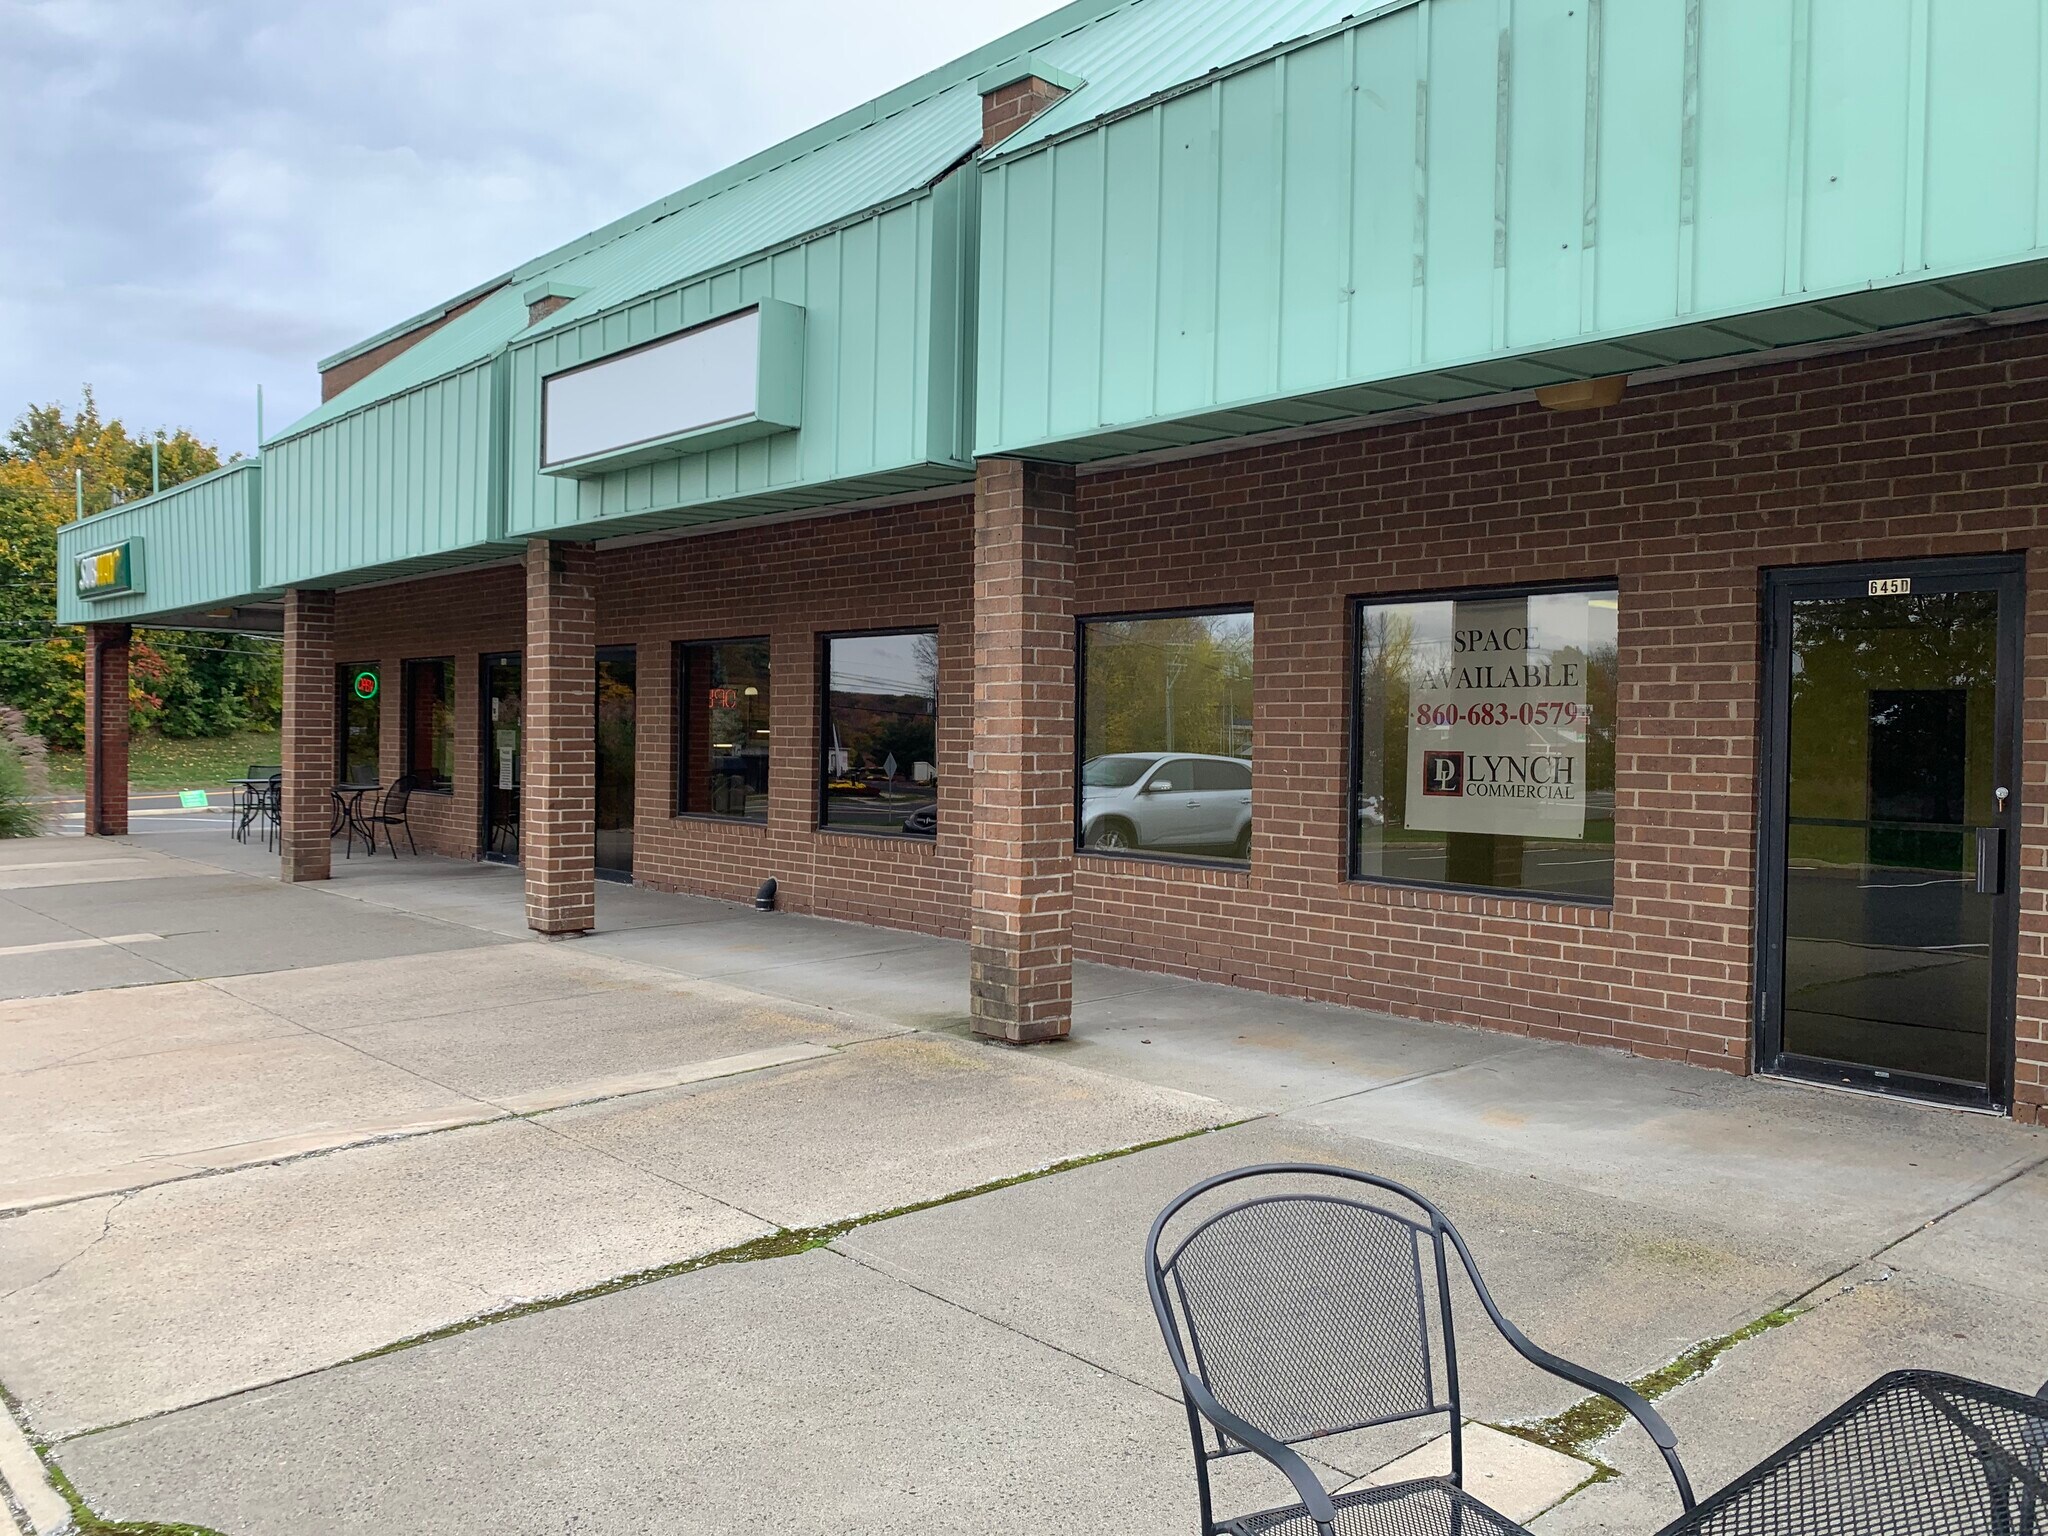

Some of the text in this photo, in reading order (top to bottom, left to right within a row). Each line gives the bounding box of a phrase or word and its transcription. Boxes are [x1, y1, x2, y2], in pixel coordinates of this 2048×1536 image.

[1454, 627, 1540, 653] SPACE
[1419, 664, 1579, 689] AVAILABLE
[1416, 701, 1578, 726] 860-683-0579
[1466, 755, 1575, 785] LYNCH
[1466, 783, 1575, 800] COMMERCIAL
